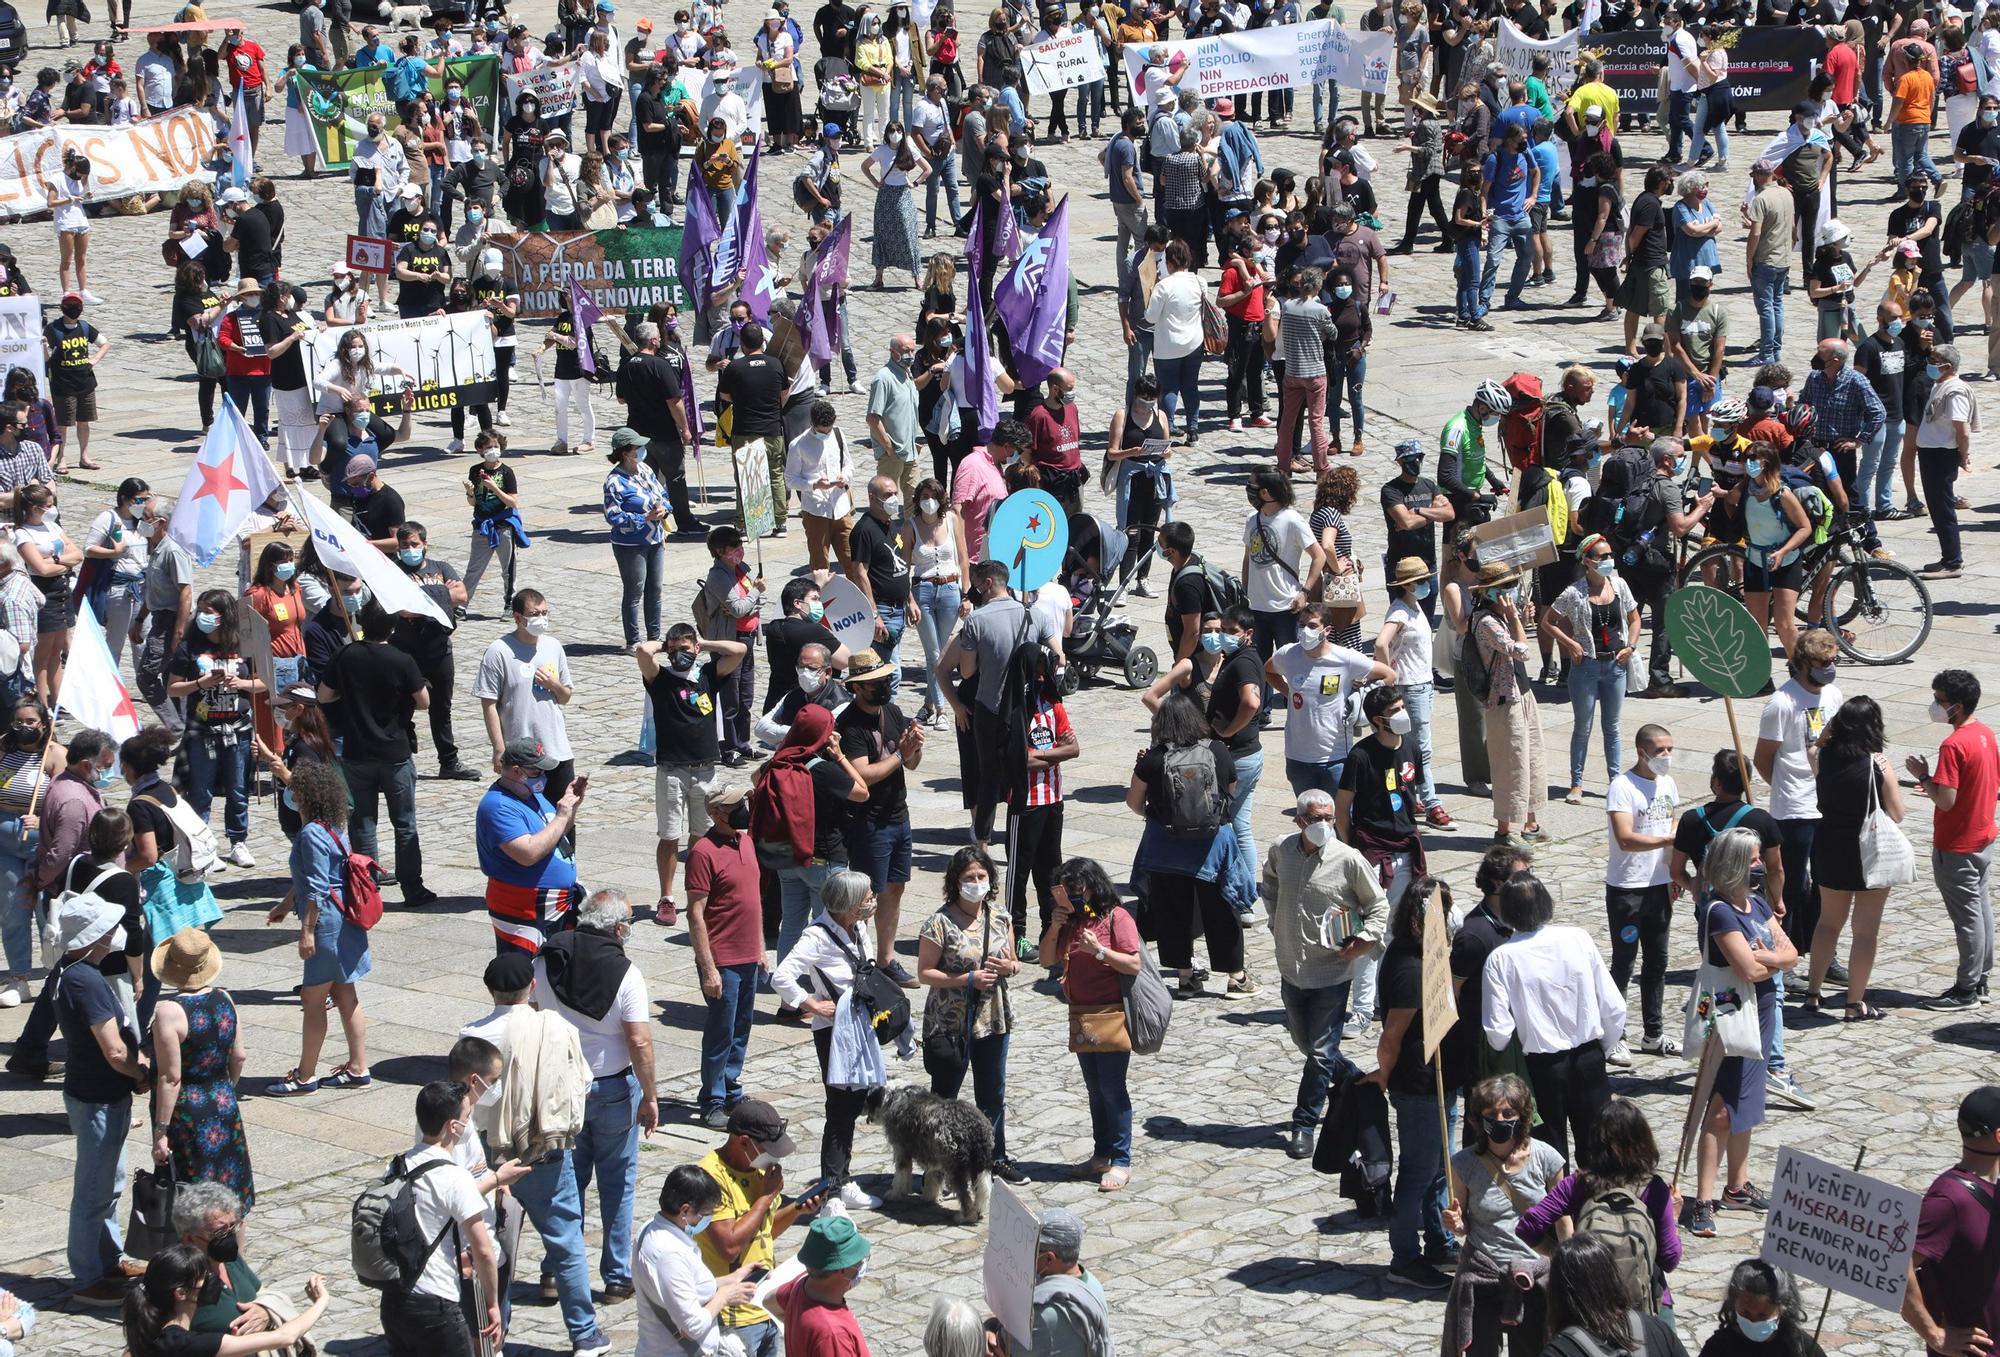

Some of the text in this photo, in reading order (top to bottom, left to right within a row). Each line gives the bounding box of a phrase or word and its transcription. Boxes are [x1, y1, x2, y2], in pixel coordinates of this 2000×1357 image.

[1038, 36, 1083, 54] SALVEMOS
[1198, 43, 1219, 56] NIN
[1059, 50, 1066, 58] O
[1198, 51, 1255, 69] ESPOLIO,
[1056, 56, 1088, 69] RURAL
[1758, 59, 1789, 73] galega
[1201, 69, 1222, 82] NIN
[1301, 70, 1308, 79] e
[1363, 63, 1388, 84] bng
[1201, 72, 1289, 95] DEPREDACIÓN
[127, 110, 218, 182] NON
[413, 256, 439, 265] NON
[522, 262, 533, 283] A
[538, 260, 596, 282] PERDA
[603, 259, 626, 280] DA
[523, 290, 560, 311] NON
[405, 319, 421, 328] Monte
[62, 336, 89, 349] NON
[71, 349, 80, 358] +
[832, 610, 866, 632] NOVA
[1807, 1172, 1871, 1209] VEÑEN
[1877, 1197, 1903, 1219] OS
